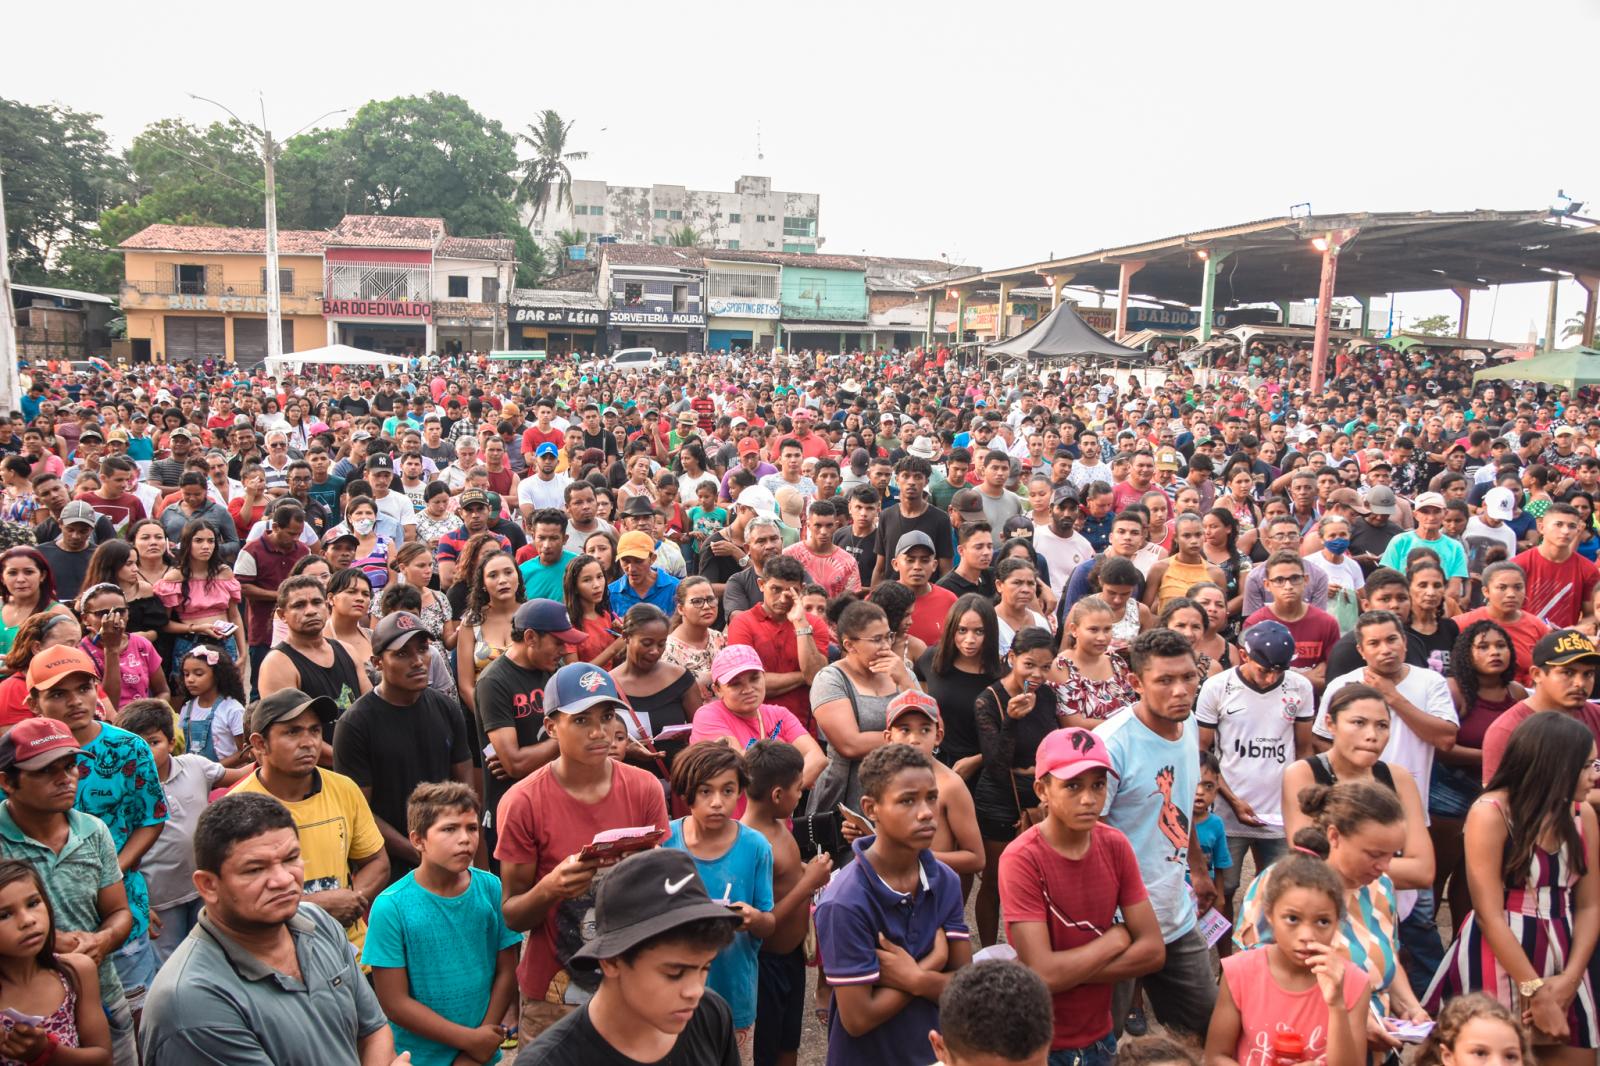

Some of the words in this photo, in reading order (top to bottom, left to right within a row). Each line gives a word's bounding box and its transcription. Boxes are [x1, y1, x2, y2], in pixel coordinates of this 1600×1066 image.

[168, 295, 207, 309] BAR
[322, 301, 349, 314] BAR
[515, 309, 546, 321] BAR
[547, 312, 562, 321] DA
[567, 310, 599, 324] LÉIA
[609, 312, 669, 323] SORVETERIA
[671, 314, 705, 324] MOURA
[1137, 308, 1170, 323] BAR
[1248, 739, 1286, 764] bmg
[90, 789, 113, 797] FILA
